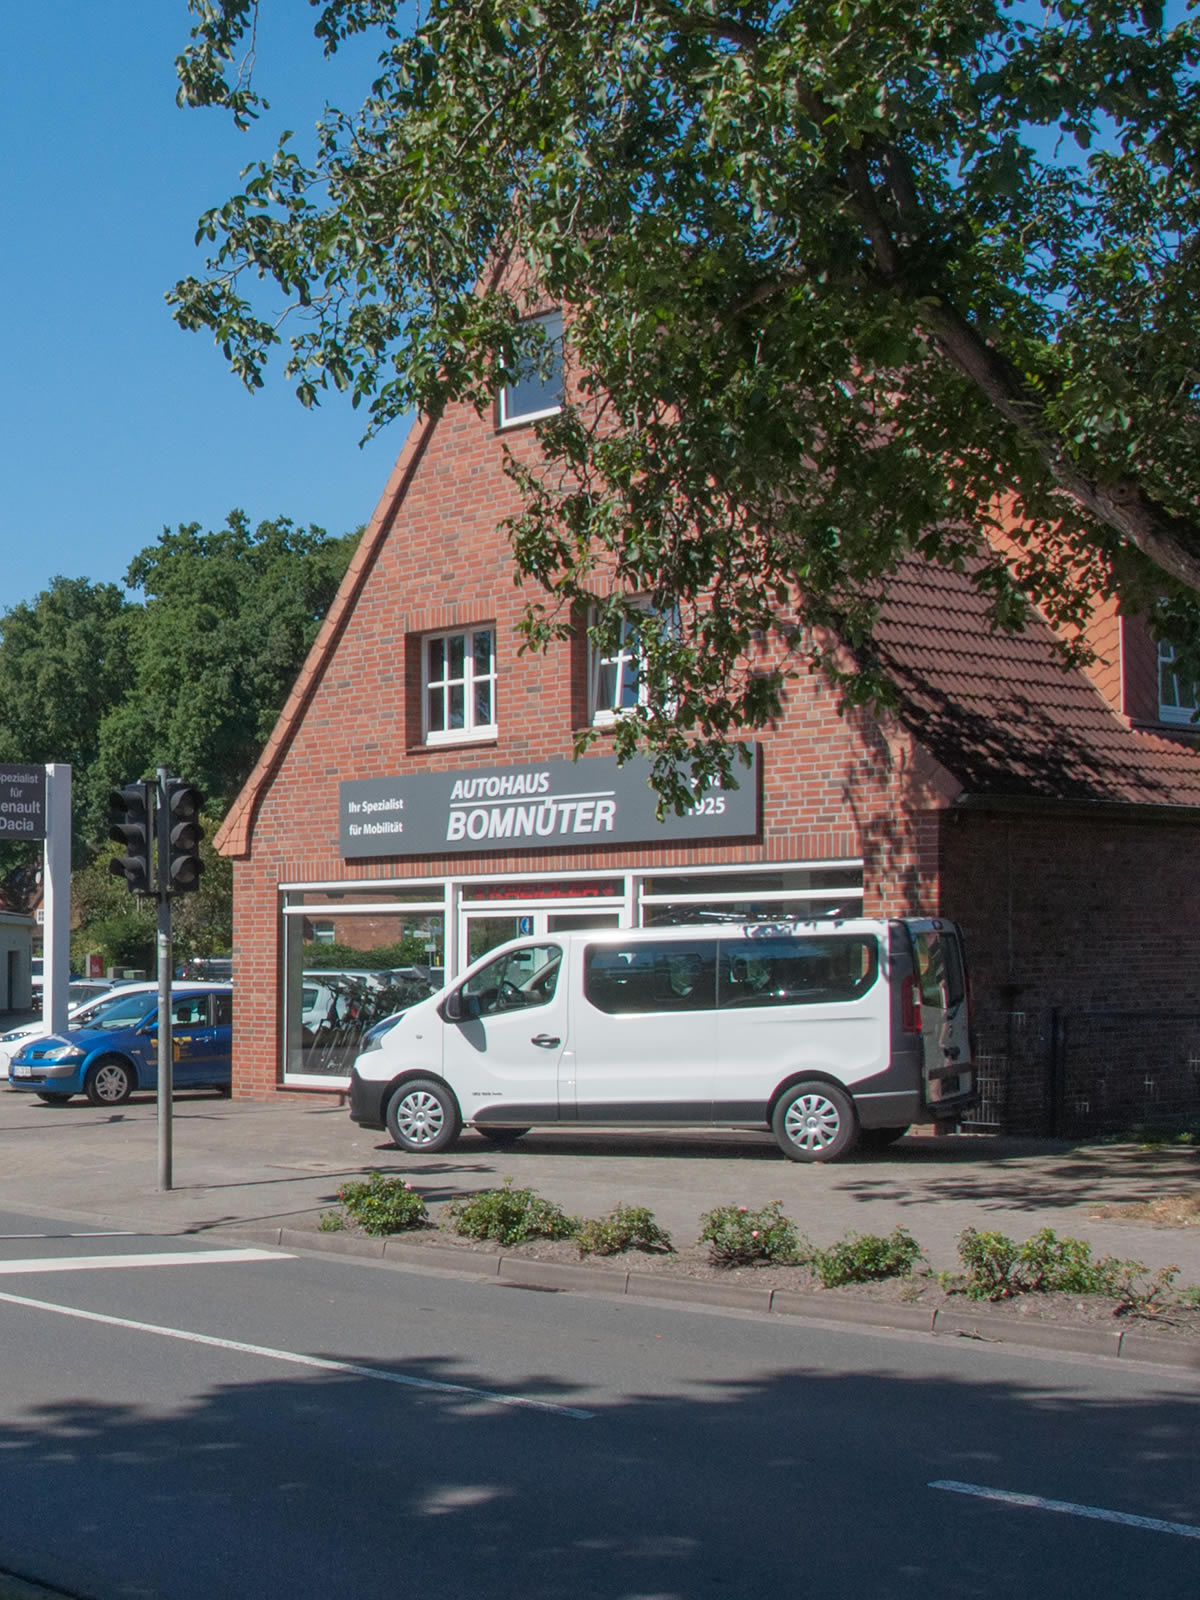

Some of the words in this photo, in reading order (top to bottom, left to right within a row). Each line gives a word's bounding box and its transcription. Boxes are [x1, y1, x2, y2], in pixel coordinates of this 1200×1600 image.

[10, 787, 22, 798] für
[450, 771, 551, 800] AUTOHAUS
[348, 801, 361, 814] Ihr
[362, 798, 403, 815] Spezialist
[446, 798, 616, 841] BOMNÜTER
[349, 823, 362, 836] für
[363, 821, 403, 835] Mobilität
